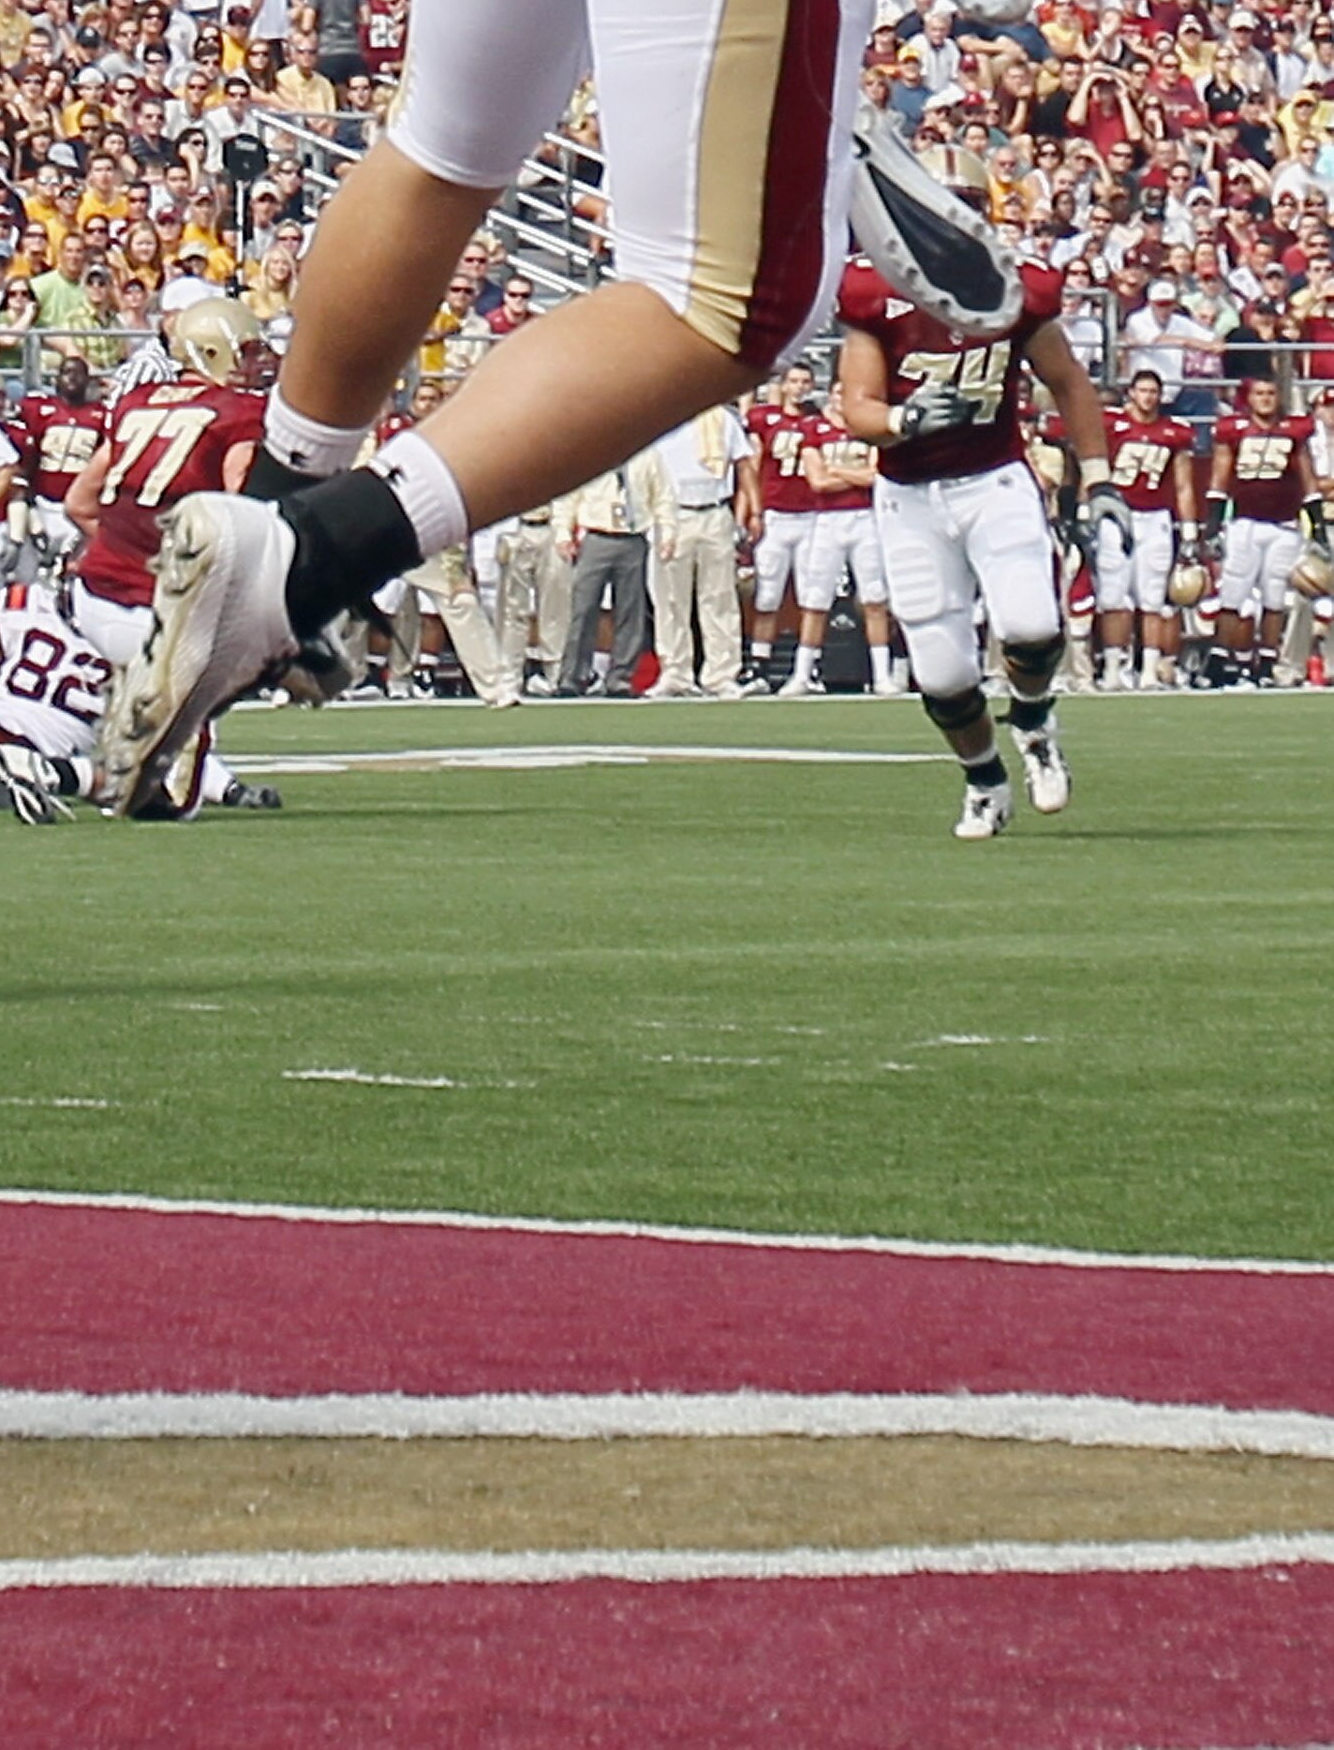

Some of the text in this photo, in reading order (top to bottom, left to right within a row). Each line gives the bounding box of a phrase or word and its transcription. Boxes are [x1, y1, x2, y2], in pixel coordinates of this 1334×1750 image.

[898, 339, 1012, 425] 74
[100, 407, 218, 507] 77
[6, 627, 113, 727] 82
